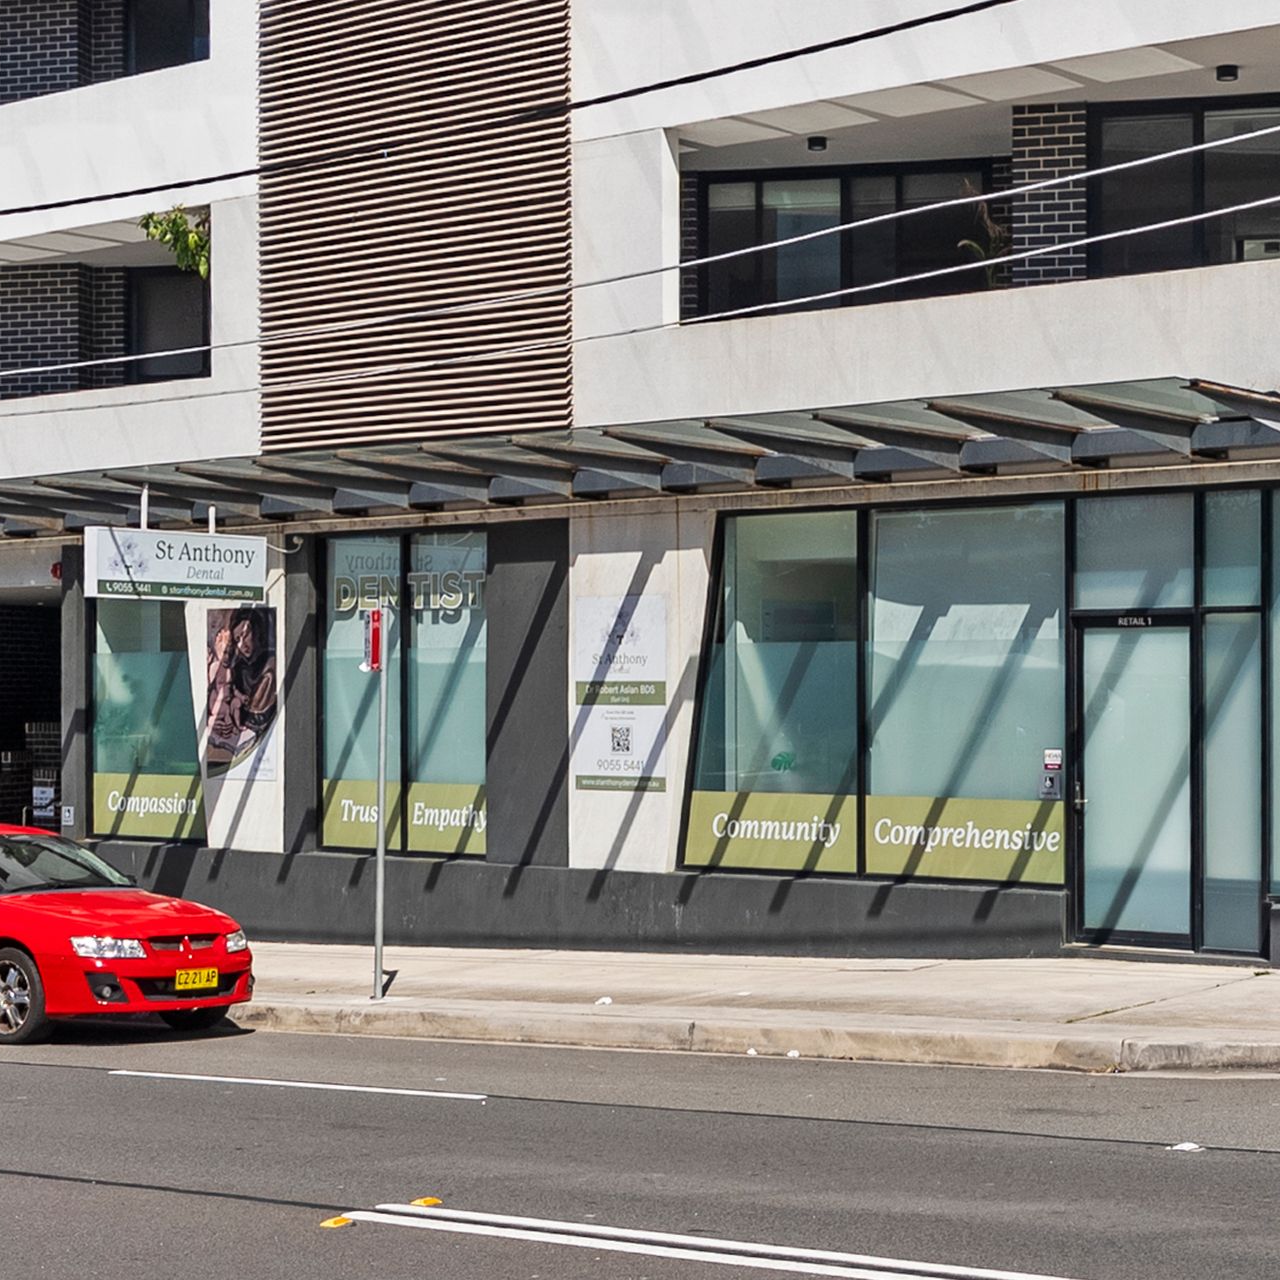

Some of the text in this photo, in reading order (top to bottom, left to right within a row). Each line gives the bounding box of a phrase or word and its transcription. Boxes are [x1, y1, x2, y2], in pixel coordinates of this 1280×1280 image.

[155, 540, 256, 569] St Anthony
[186, 566, 225, 580] Dental
[112, 582, 133, 593] 9055
[334, 571, 486, 611] DENTIST
[1118, 617, 1146, 626] RETAIL
[604, 653, 648, 666] Anthony
[597, 760, 622, 771] 9055
[107, 790, 197, 818] Compassion
[340, 799, 379, 824] Trus
[412, 802, 487, 833] Empathy
[712, 812, 840, 848] Community
[874, 818, 1062, 853] Comprehensive
